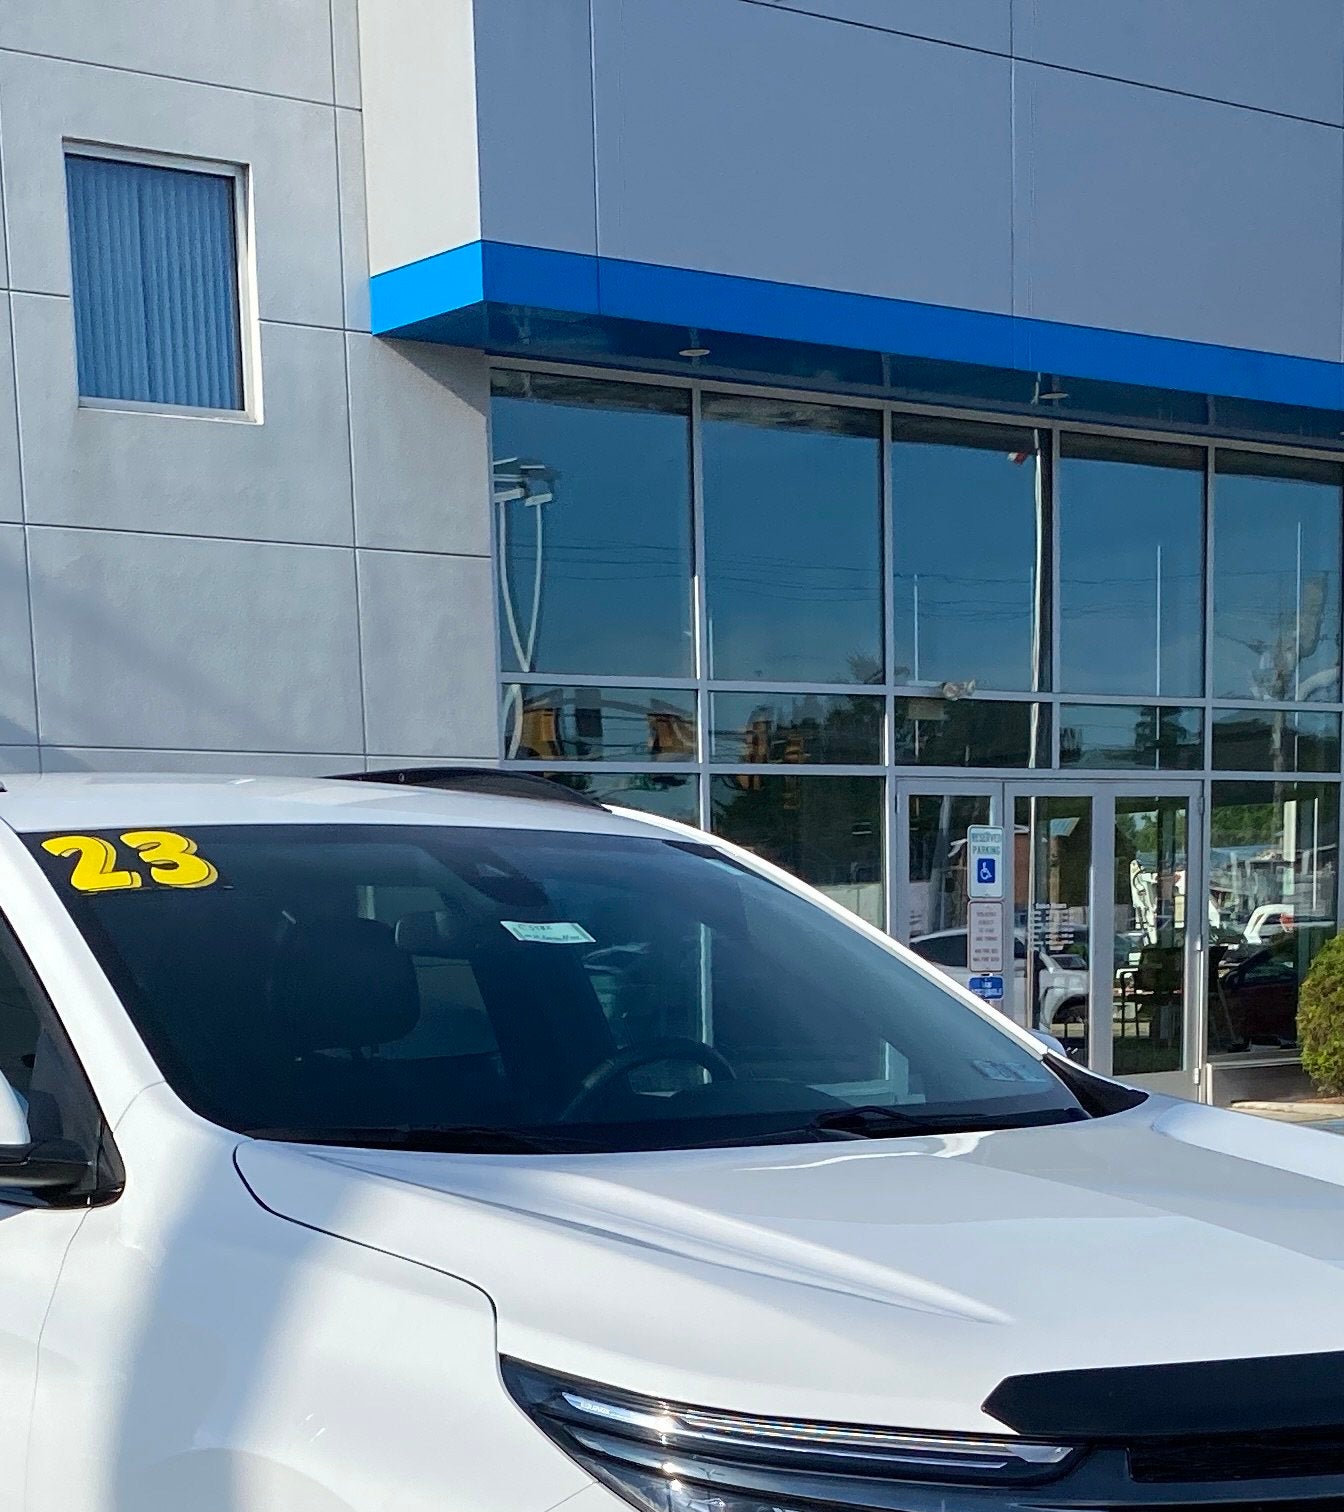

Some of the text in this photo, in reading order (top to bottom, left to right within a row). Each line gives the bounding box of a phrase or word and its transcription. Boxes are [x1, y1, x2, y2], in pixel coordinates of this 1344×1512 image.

[971, 832, 1001, 843] RESERVED
[972, 846, 1001, 855] PARKING
[41, 830, 219, 891] 23
